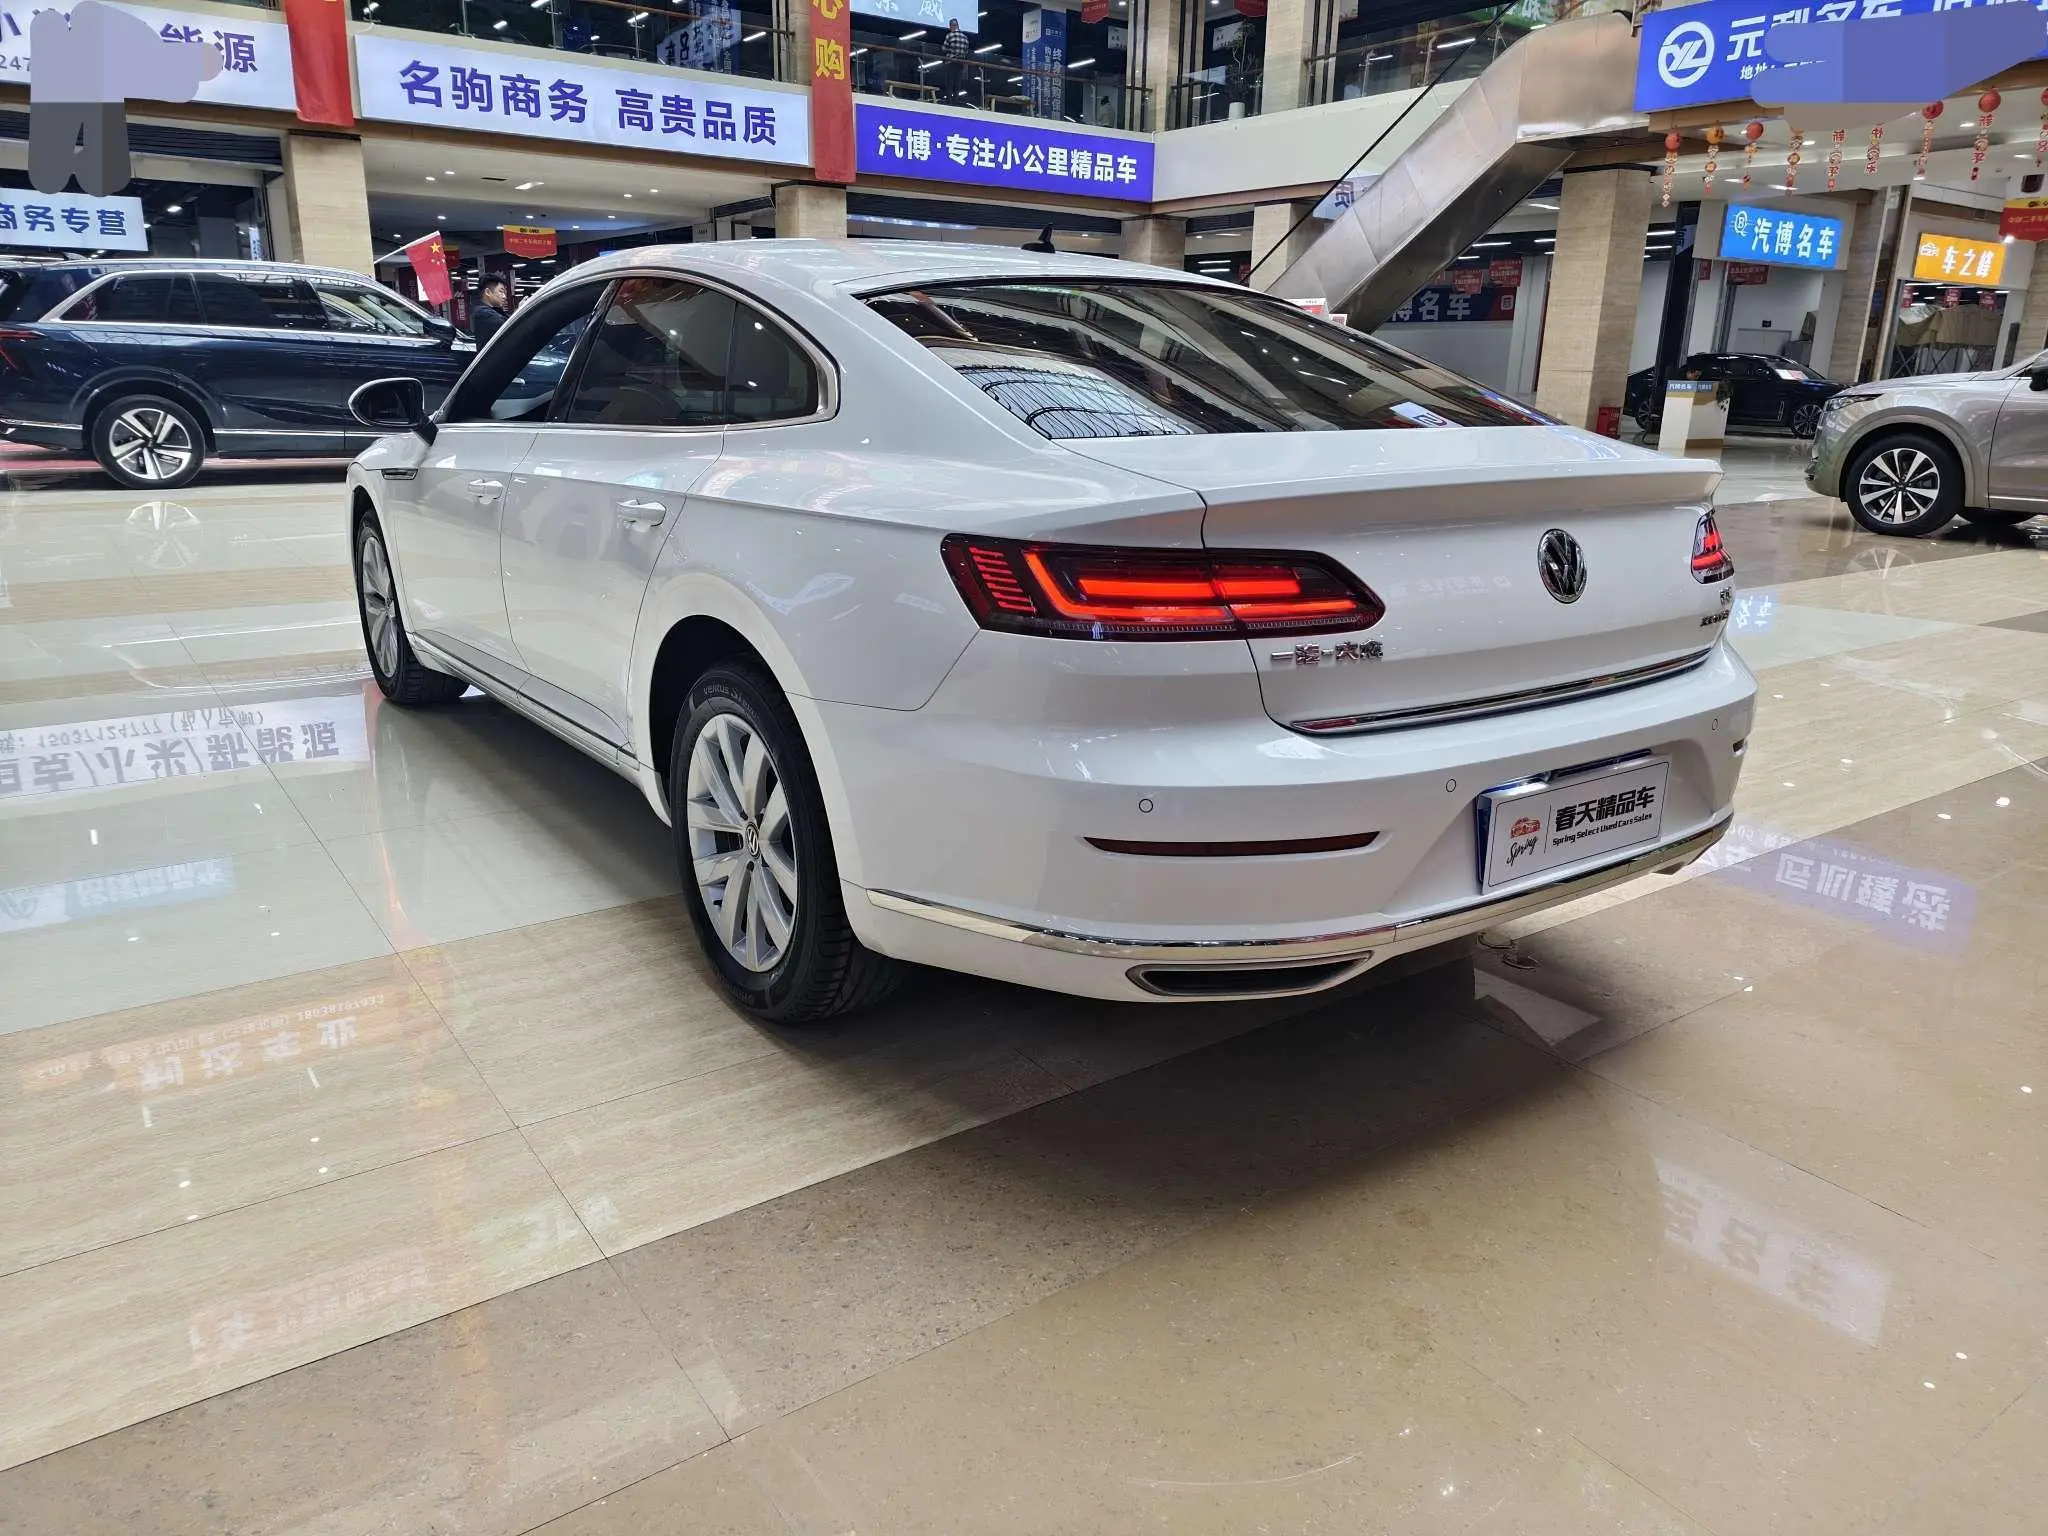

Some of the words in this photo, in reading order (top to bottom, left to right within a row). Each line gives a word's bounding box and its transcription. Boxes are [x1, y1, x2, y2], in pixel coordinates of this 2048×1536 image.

[400, 60, 587, 124] 名驹商务
[615, 87, 777, 146] 高贵品质
[1751, 217, 1836, 260] 汽博名车
[1552, 832, 1576, 847] Spring
[1577, 826, 1600, 839] Select
[1600, 820, 1618, 833] Used
[1618, 817, 1633, 829] Cars
[1634, 813, 1652, 823] Sales
[1556, 786, 1656, 832] 春天精品车
